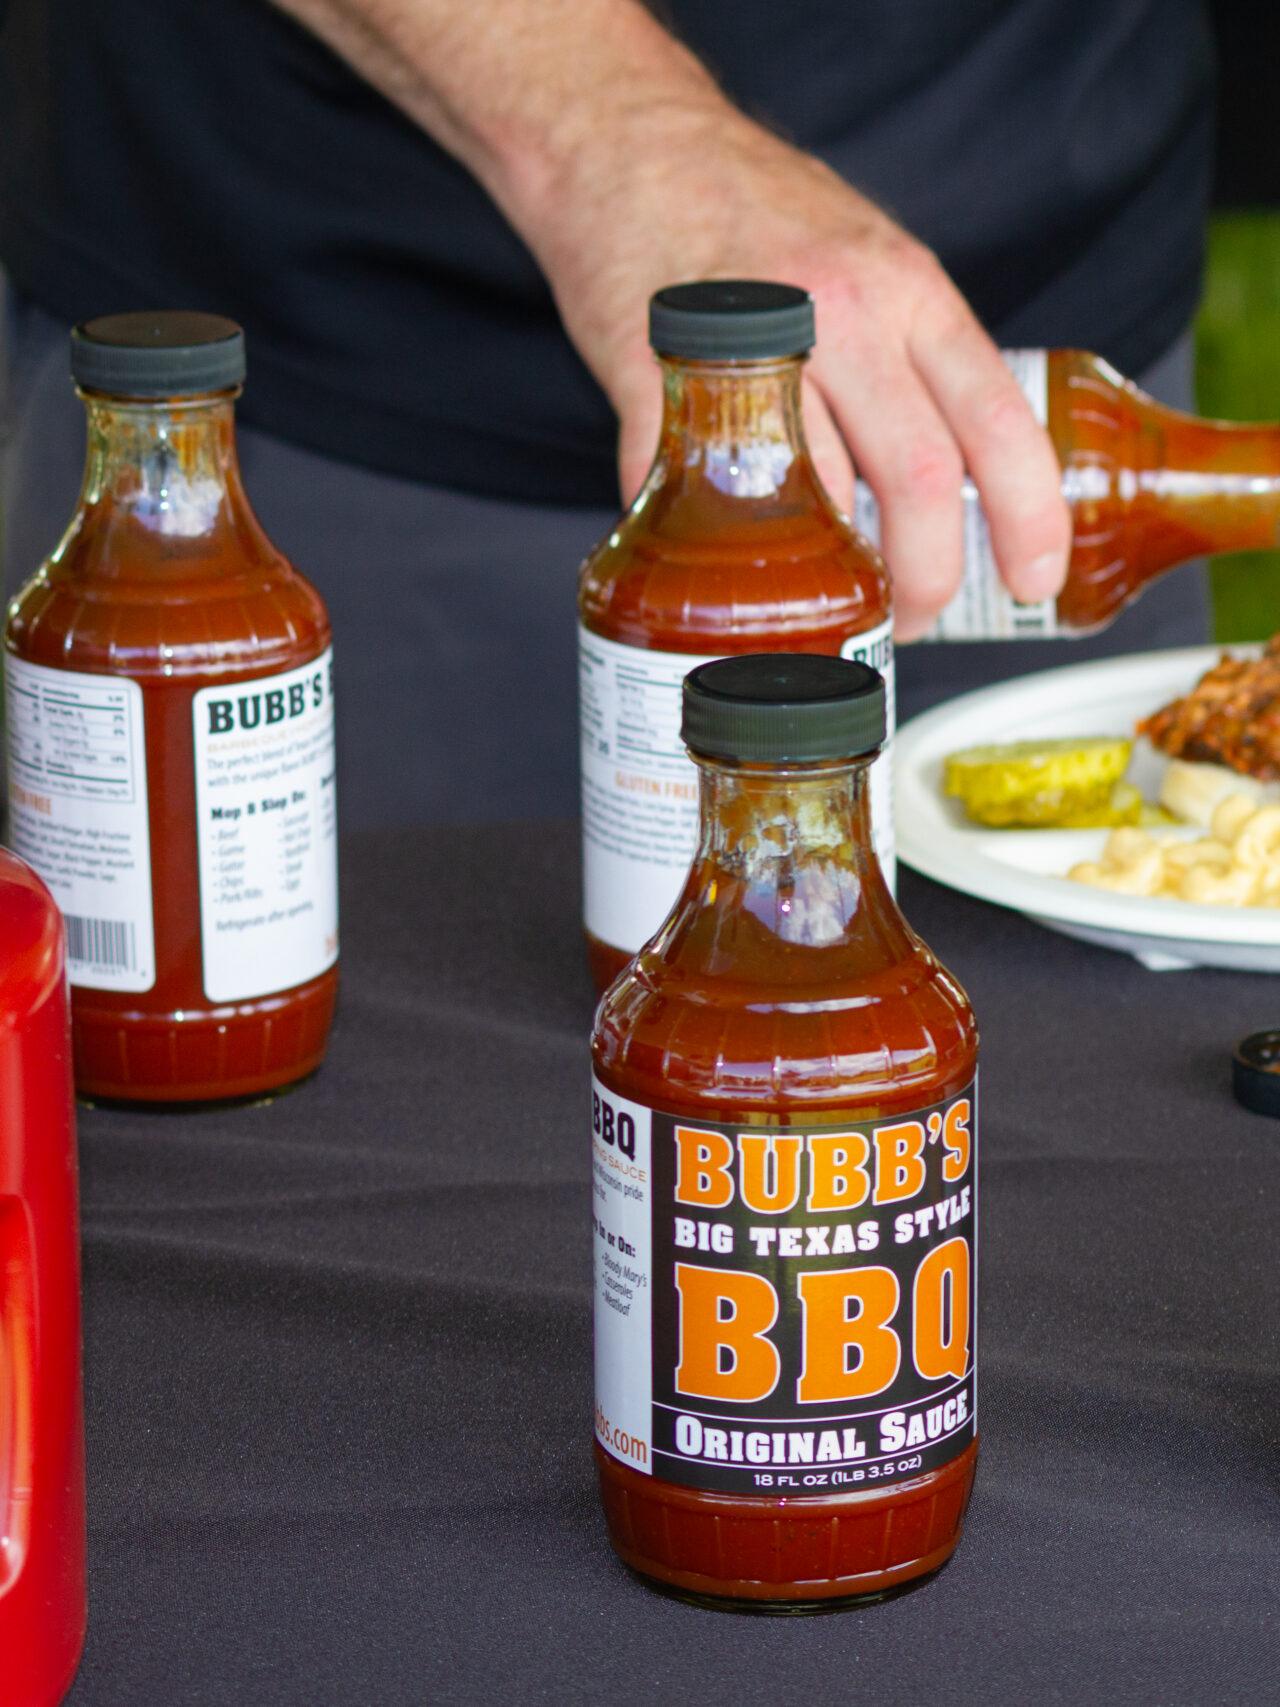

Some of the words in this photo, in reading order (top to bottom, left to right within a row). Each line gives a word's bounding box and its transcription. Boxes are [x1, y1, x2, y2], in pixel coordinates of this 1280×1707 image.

[207, 672, 322, 734] BUBB'S
[615, 771, 661, 797] GLUTEN
[210, 807, 242, 821] Mop
[593, 1087, 636, 1162] BBQ
[608, 1154, 648, 1184] SAUCE
[674, 1098, 971, 1215] BUBB'S
[674, 1216, 735, 1255] BIG
[749, 1221, 880, 1257] TEXAS
[894, 1186, 971, 1245] STYLE
[618, 1235, 636, 1258] On:
[674, 1236, 971, 1404] BBQ
[753, 1473, 773, 1486] 18
[777, 1474, 800, 1487] FL
[803, 1473, 828, 1486] OZ
[831, 1469, 866, 1486] (1LB
[867, 1464, 895, 1480] 3.5
[897, 1454, 923, 1472] OZ)
